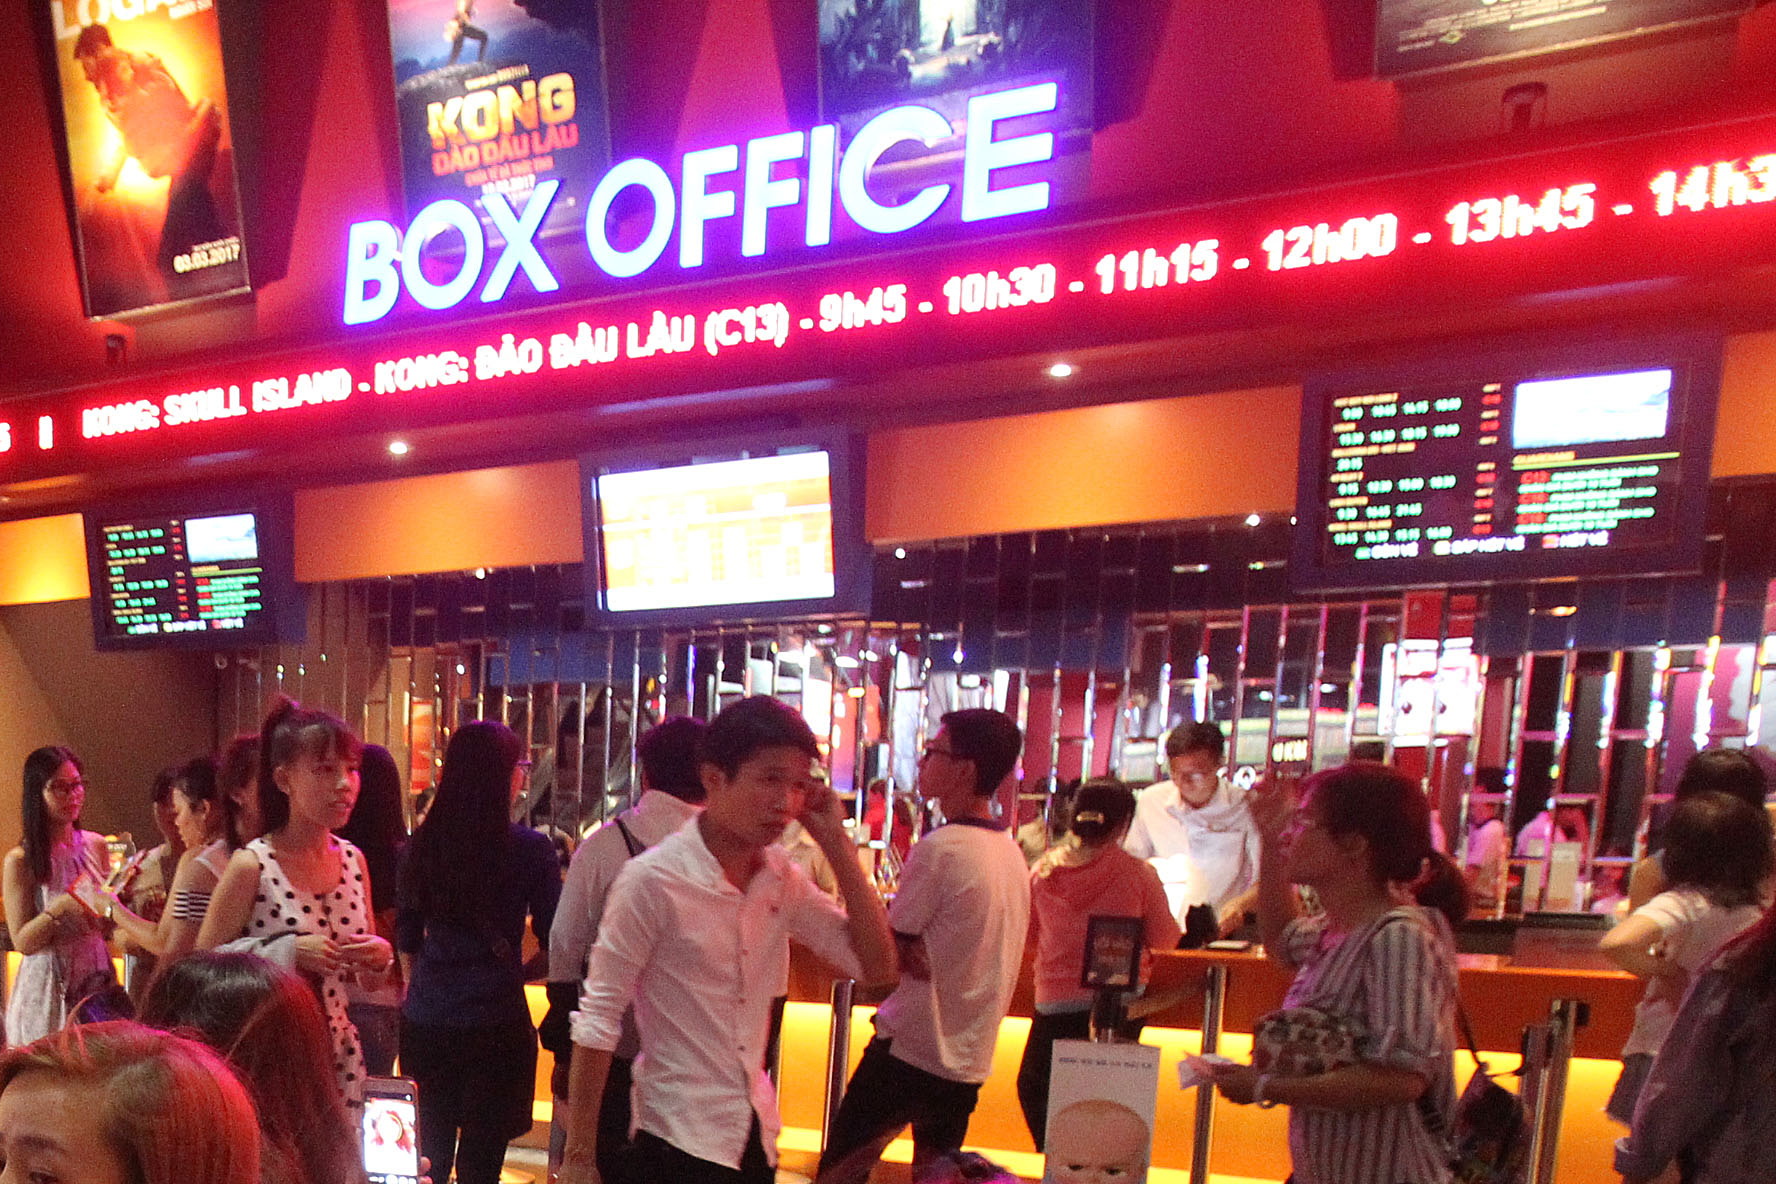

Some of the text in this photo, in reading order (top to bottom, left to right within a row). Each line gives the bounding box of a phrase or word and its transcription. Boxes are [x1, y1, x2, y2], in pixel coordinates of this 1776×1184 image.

[343, 82, 1057, 326] BOX OFFICE
[427, 72, 576, 149] KONG
[82, 399, 160, 438] KONG:
[163, 386, 247, 426] SKULL
[252, 368, 351, 412] ISLAND
[374, 350, 468, 394] KONG:
[704, 302, 789, 356] (C13)
[819, 283, 906, 332] 9h45
[943, 264, 1056, 314] 10h30
[1095, 239, 1218, 294] 11h15
[1261, 213, 1398, 271] 12h00
[1445, 183, 1596, 245] 13h45
